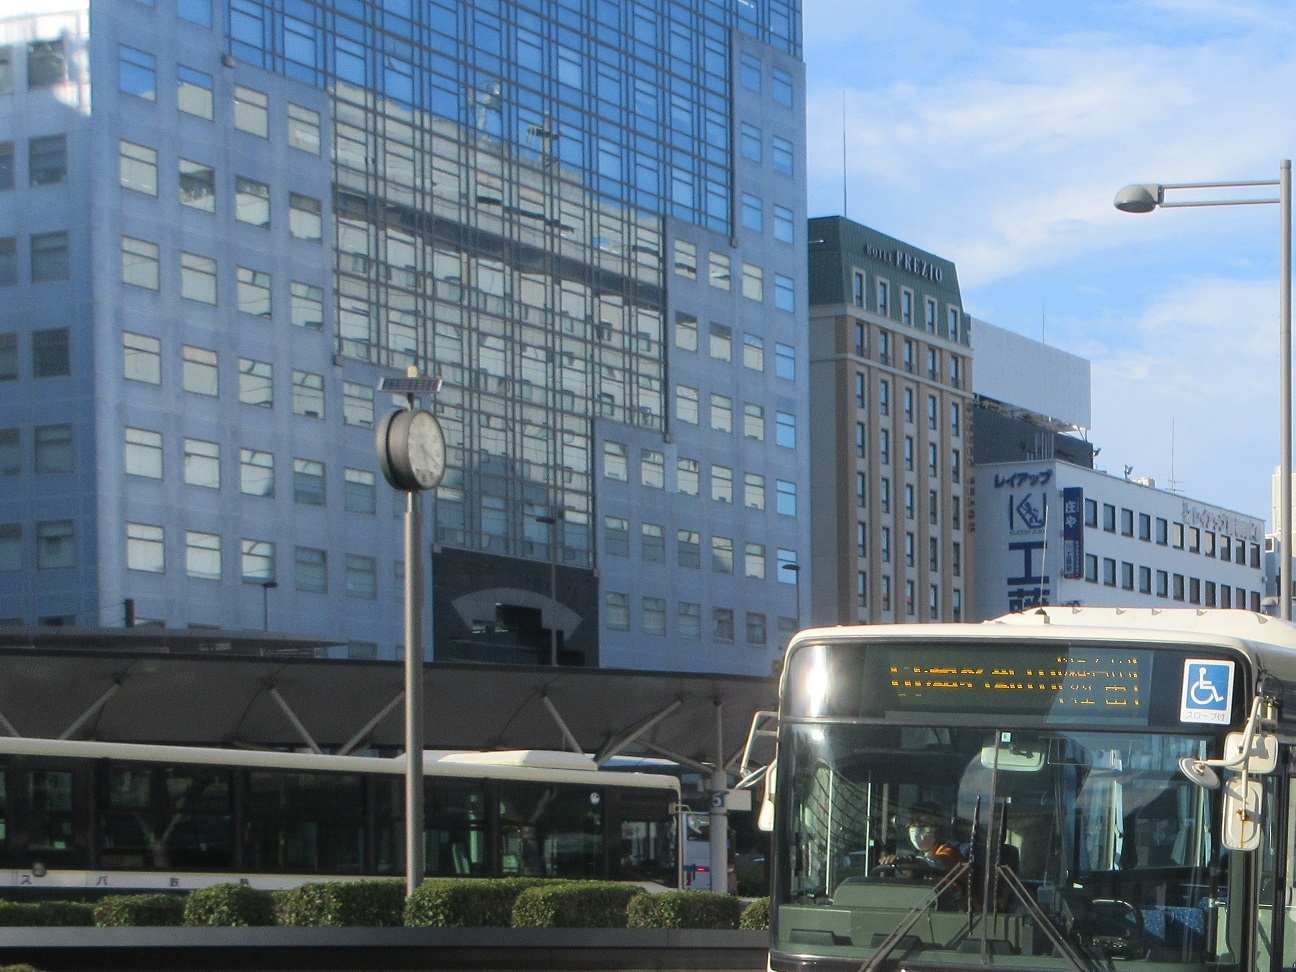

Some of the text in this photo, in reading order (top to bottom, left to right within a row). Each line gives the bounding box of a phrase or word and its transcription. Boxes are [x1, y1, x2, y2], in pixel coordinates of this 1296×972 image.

[896, 249, 943, 283] PREZIO
[994, 469, 1053, 489] レイアップ
[712, 794, 721, 807] 5
